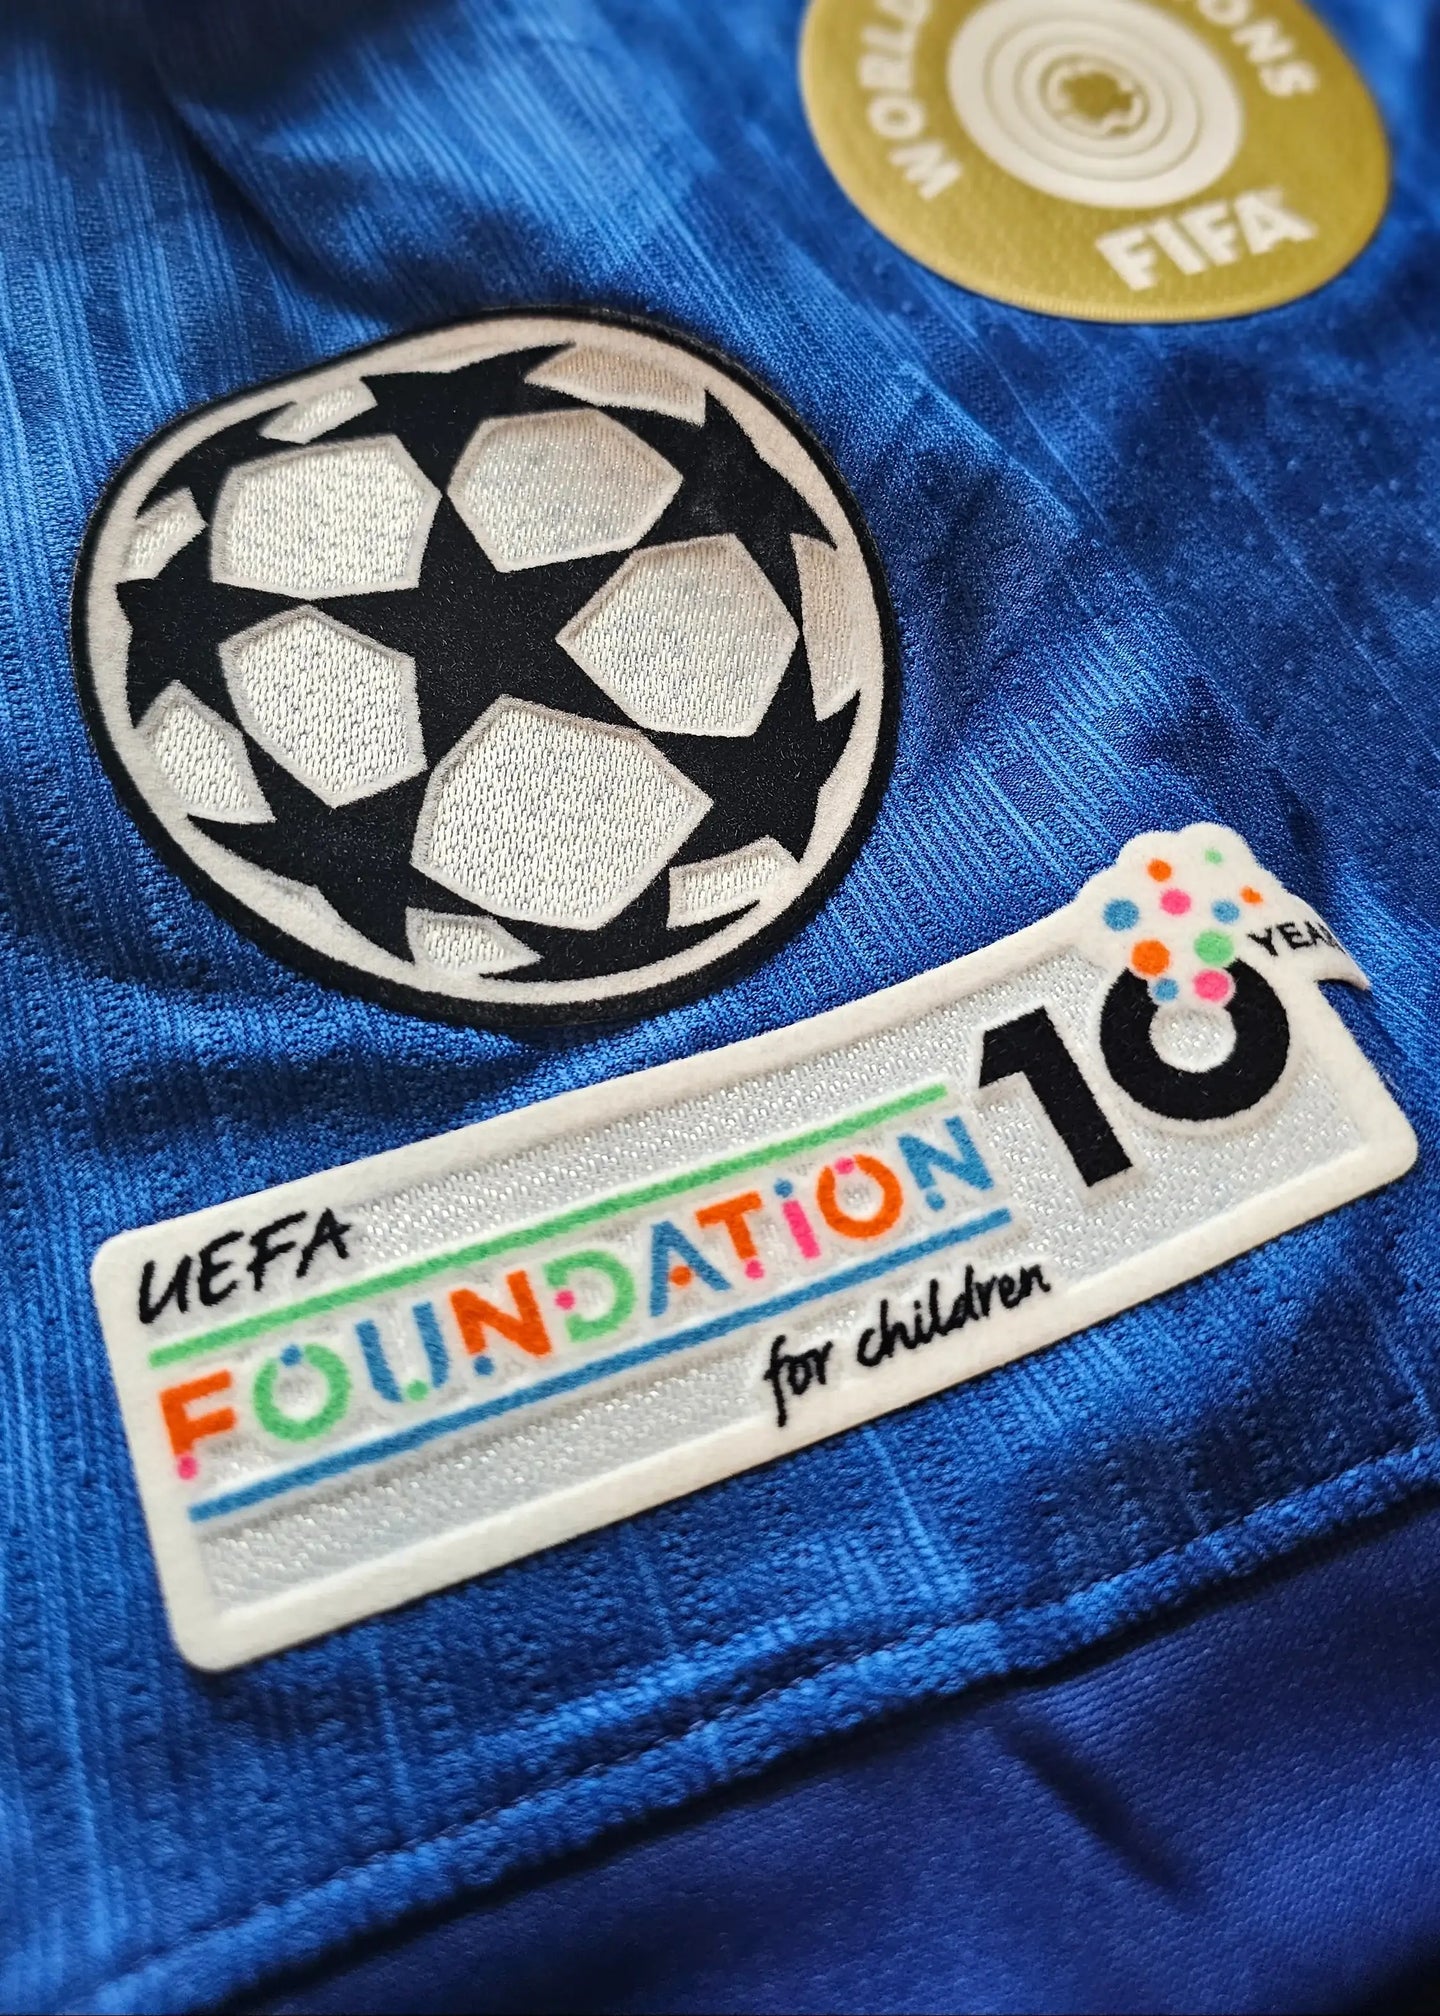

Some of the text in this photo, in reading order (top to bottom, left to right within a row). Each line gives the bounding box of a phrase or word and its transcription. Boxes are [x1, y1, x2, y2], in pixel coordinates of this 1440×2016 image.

[1095, 186, 1319, 292] FIFA
[978, 957, 1291, 1188] 10
[138, 1206, 352, 1325] UEFA
[158, 1114, 994, 1481] FOUNDATION
[763, 1263, 1053, 1428] for children
